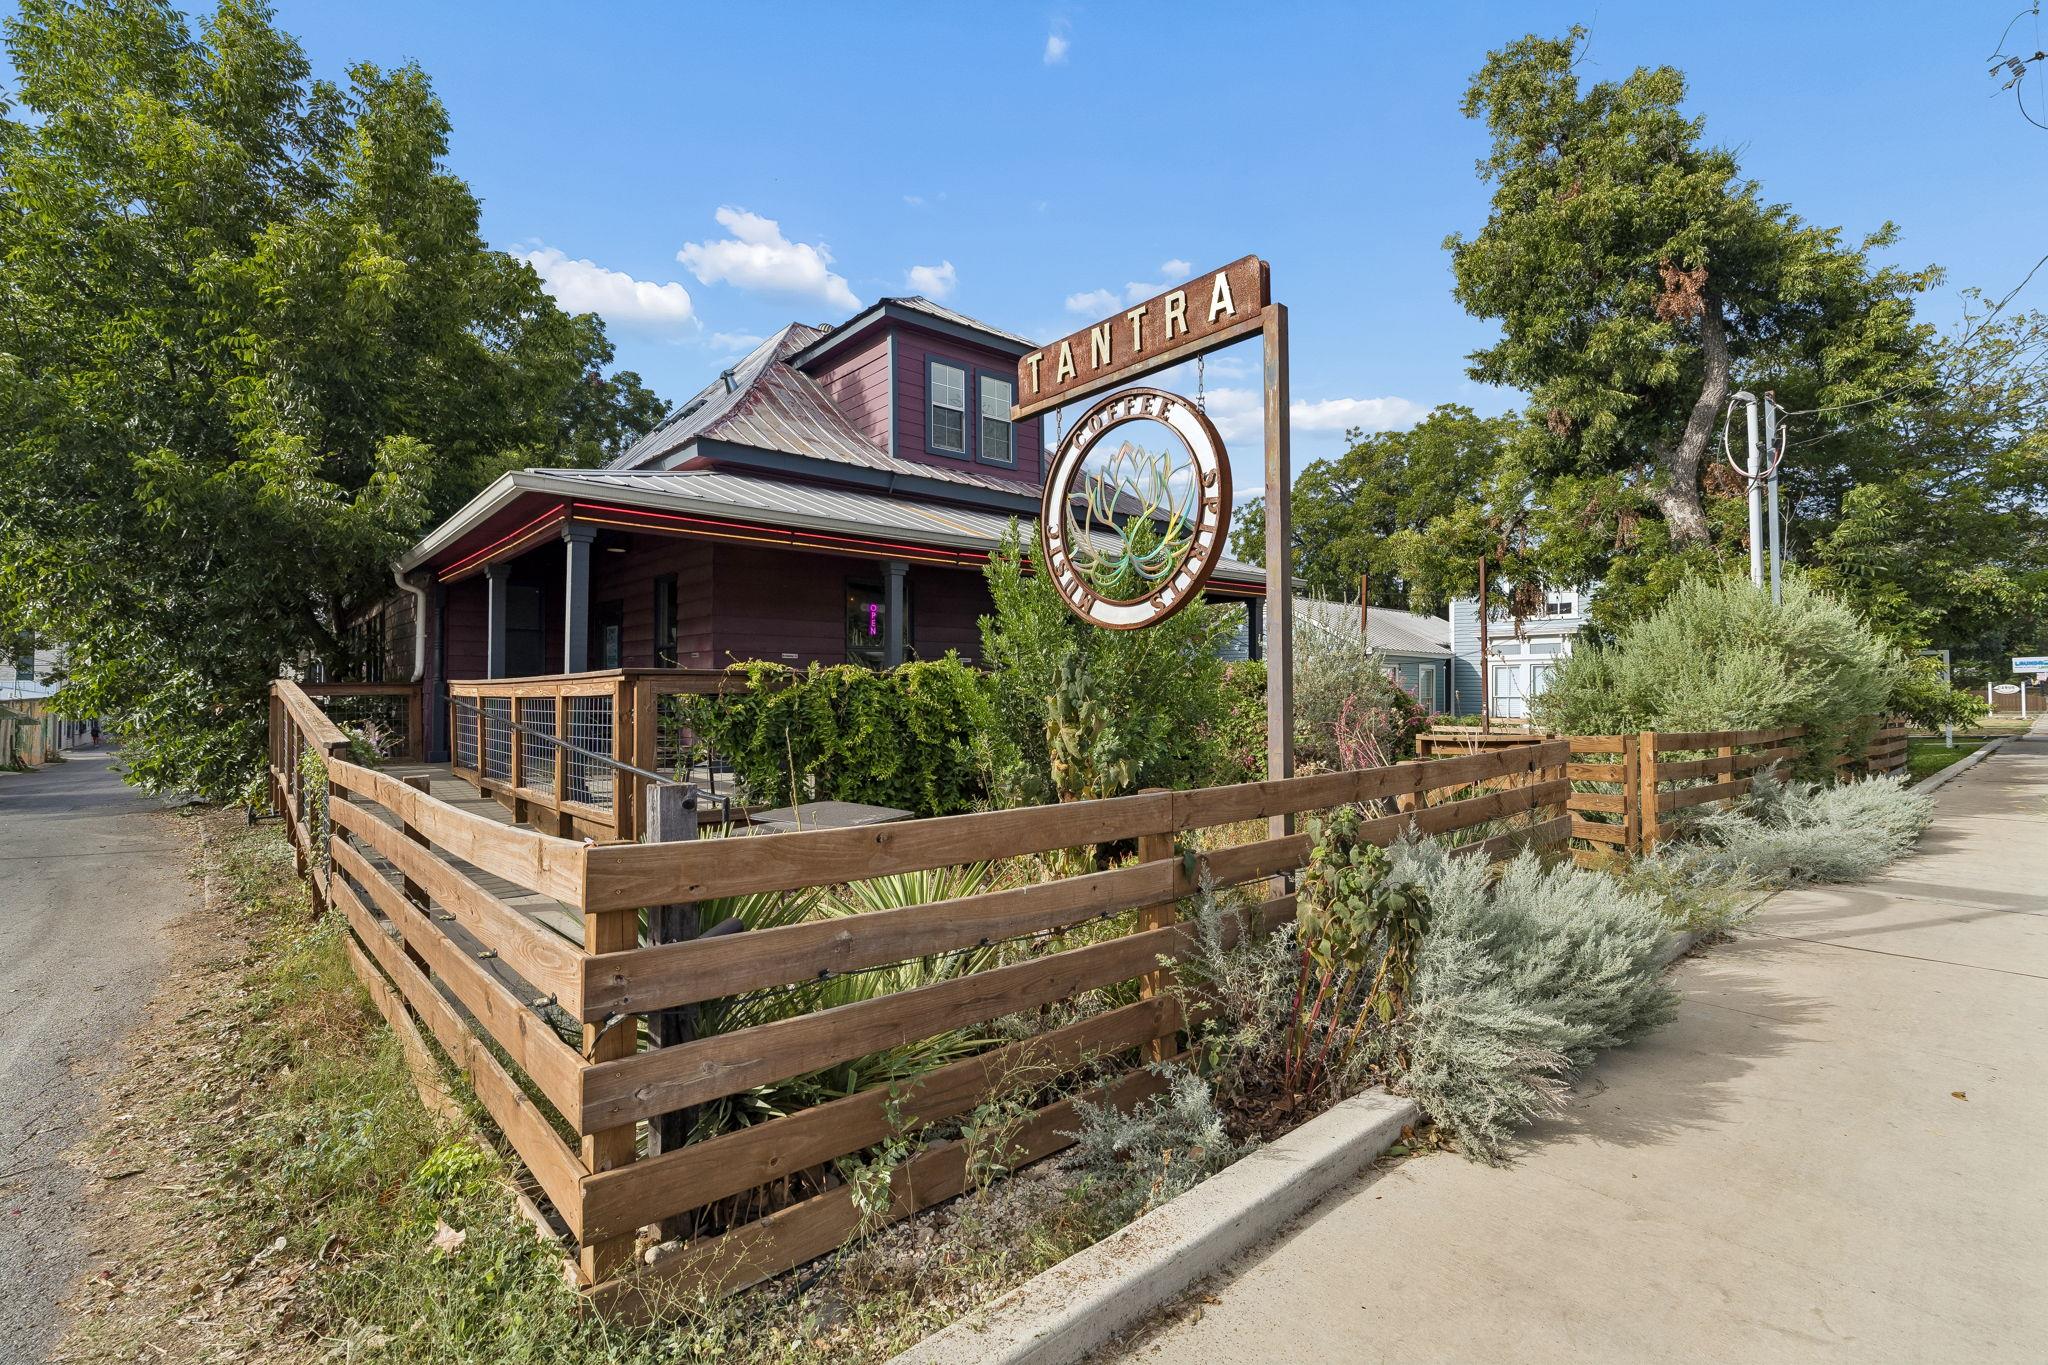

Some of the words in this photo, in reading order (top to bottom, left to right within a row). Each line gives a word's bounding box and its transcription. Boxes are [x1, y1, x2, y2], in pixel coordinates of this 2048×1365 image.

[1027, 270, 1236, 394] TANTRA
[1072, 394, 1175, 449] COFFEE
[1047, 523, 1096, 615] MUSIC
[1150, 468, 1220, 614] SPIRITS
